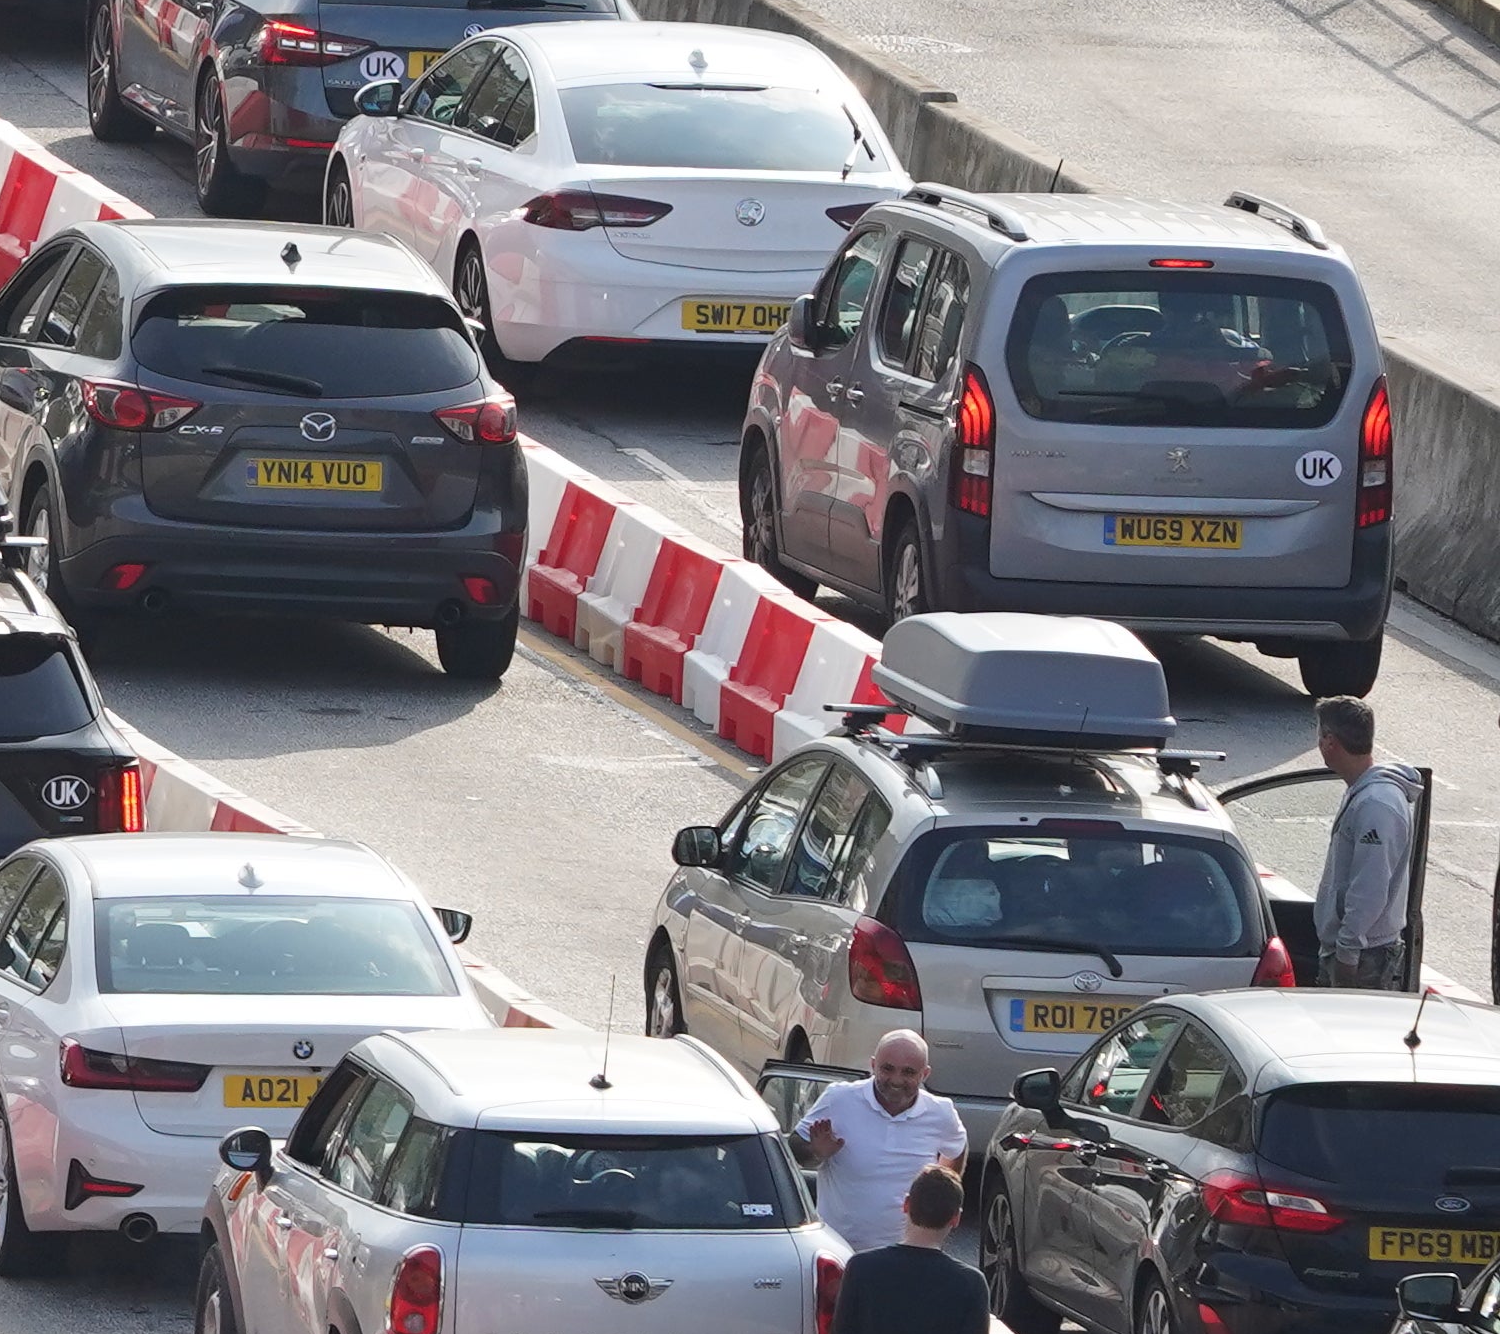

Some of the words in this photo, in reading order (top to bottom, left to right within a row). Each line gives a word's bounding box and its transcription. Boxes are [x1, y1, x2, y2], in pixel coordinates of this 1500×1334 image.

[366, 56, 399, 78] UK
[695, 303, 745, 325] SW17
[178, 424, 225, 435] CX-5
[261, 461, 314, 484] YN14
[322, 463, 366, 485] VUO
[1302, 457, 1335, 480] UK
[1120, 519, 1183, 541] WU69
[1190, 522, 1238, 544] XZN
[50, 781, 80, 805] UK
[1033, 1004, 1075, 1028] ROI
[1380, 1231, 1453, 1257] FP69
[1460, 1234, 1499, 1259] MB
